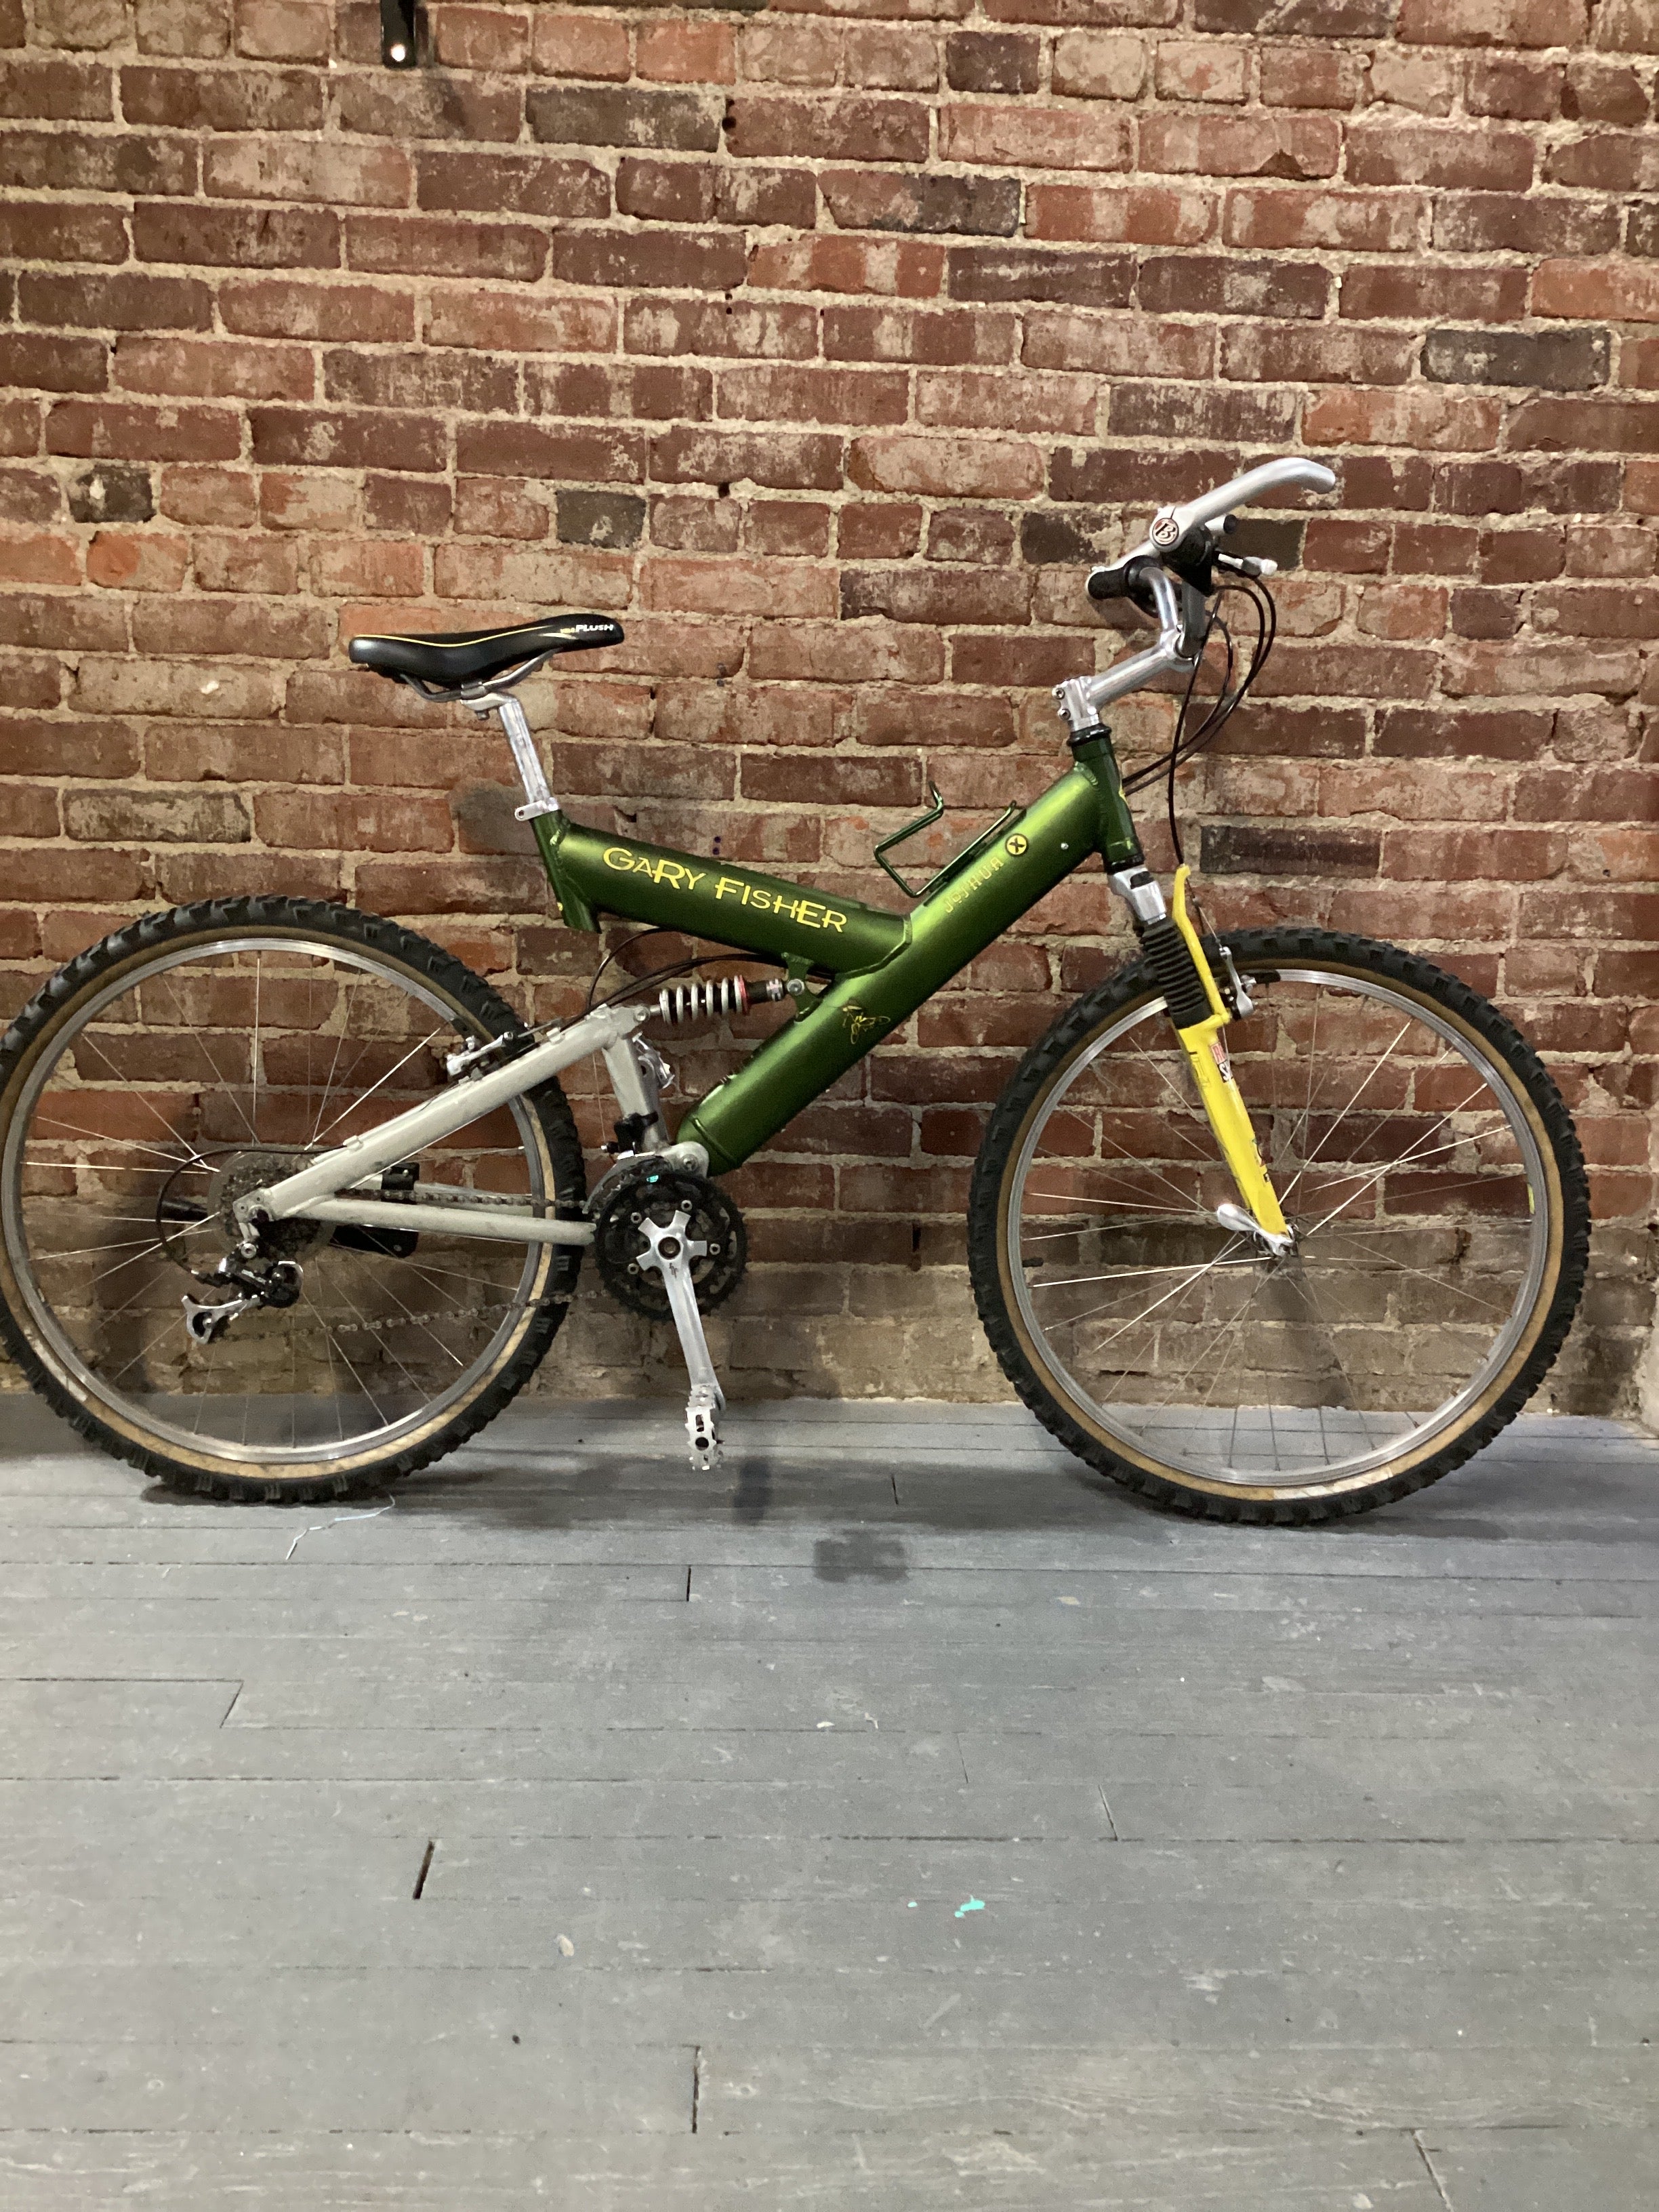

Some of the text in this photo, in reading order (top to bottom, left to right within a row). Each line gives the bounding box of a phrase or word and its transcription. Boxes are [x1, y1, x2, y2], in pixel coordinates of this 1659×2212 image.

[575, 624, 614, 633] PLUSH
[602, 847, 847, 933] GARY FISHER
